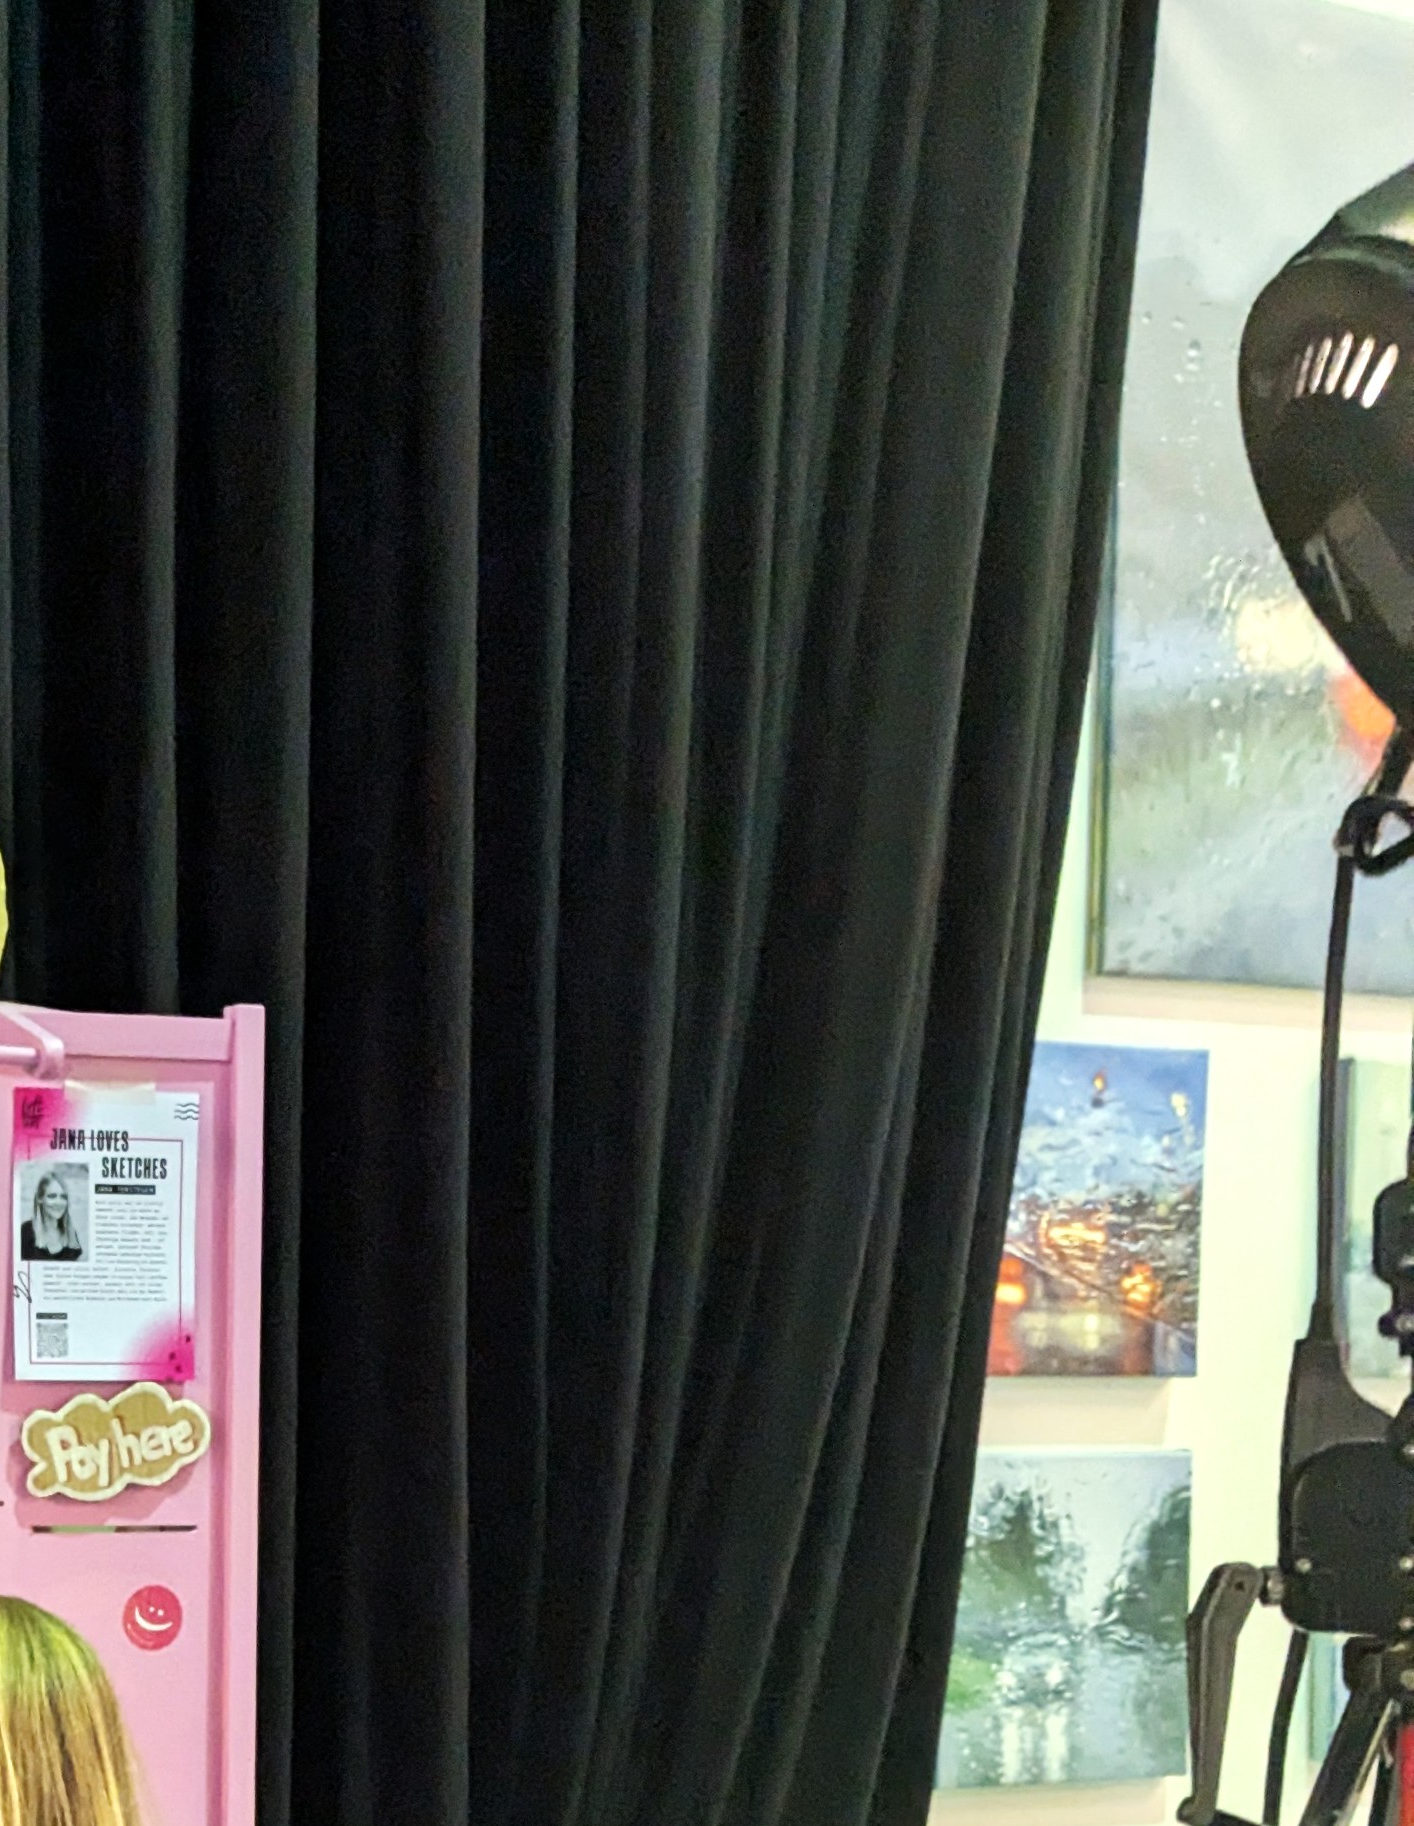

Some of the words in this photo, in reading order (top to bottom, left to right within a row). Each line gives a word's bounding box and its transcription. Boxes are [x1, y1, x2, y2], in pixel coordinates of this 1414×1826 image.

[50, 1127, 85, 1150] JANA
[90, 1129, 129, 1152] LOVES
[101, 1156, 168, 1179] SKETCHES
[45, 1425, 110, 1488] Pay
[110, 1418, 195, 1469] here
